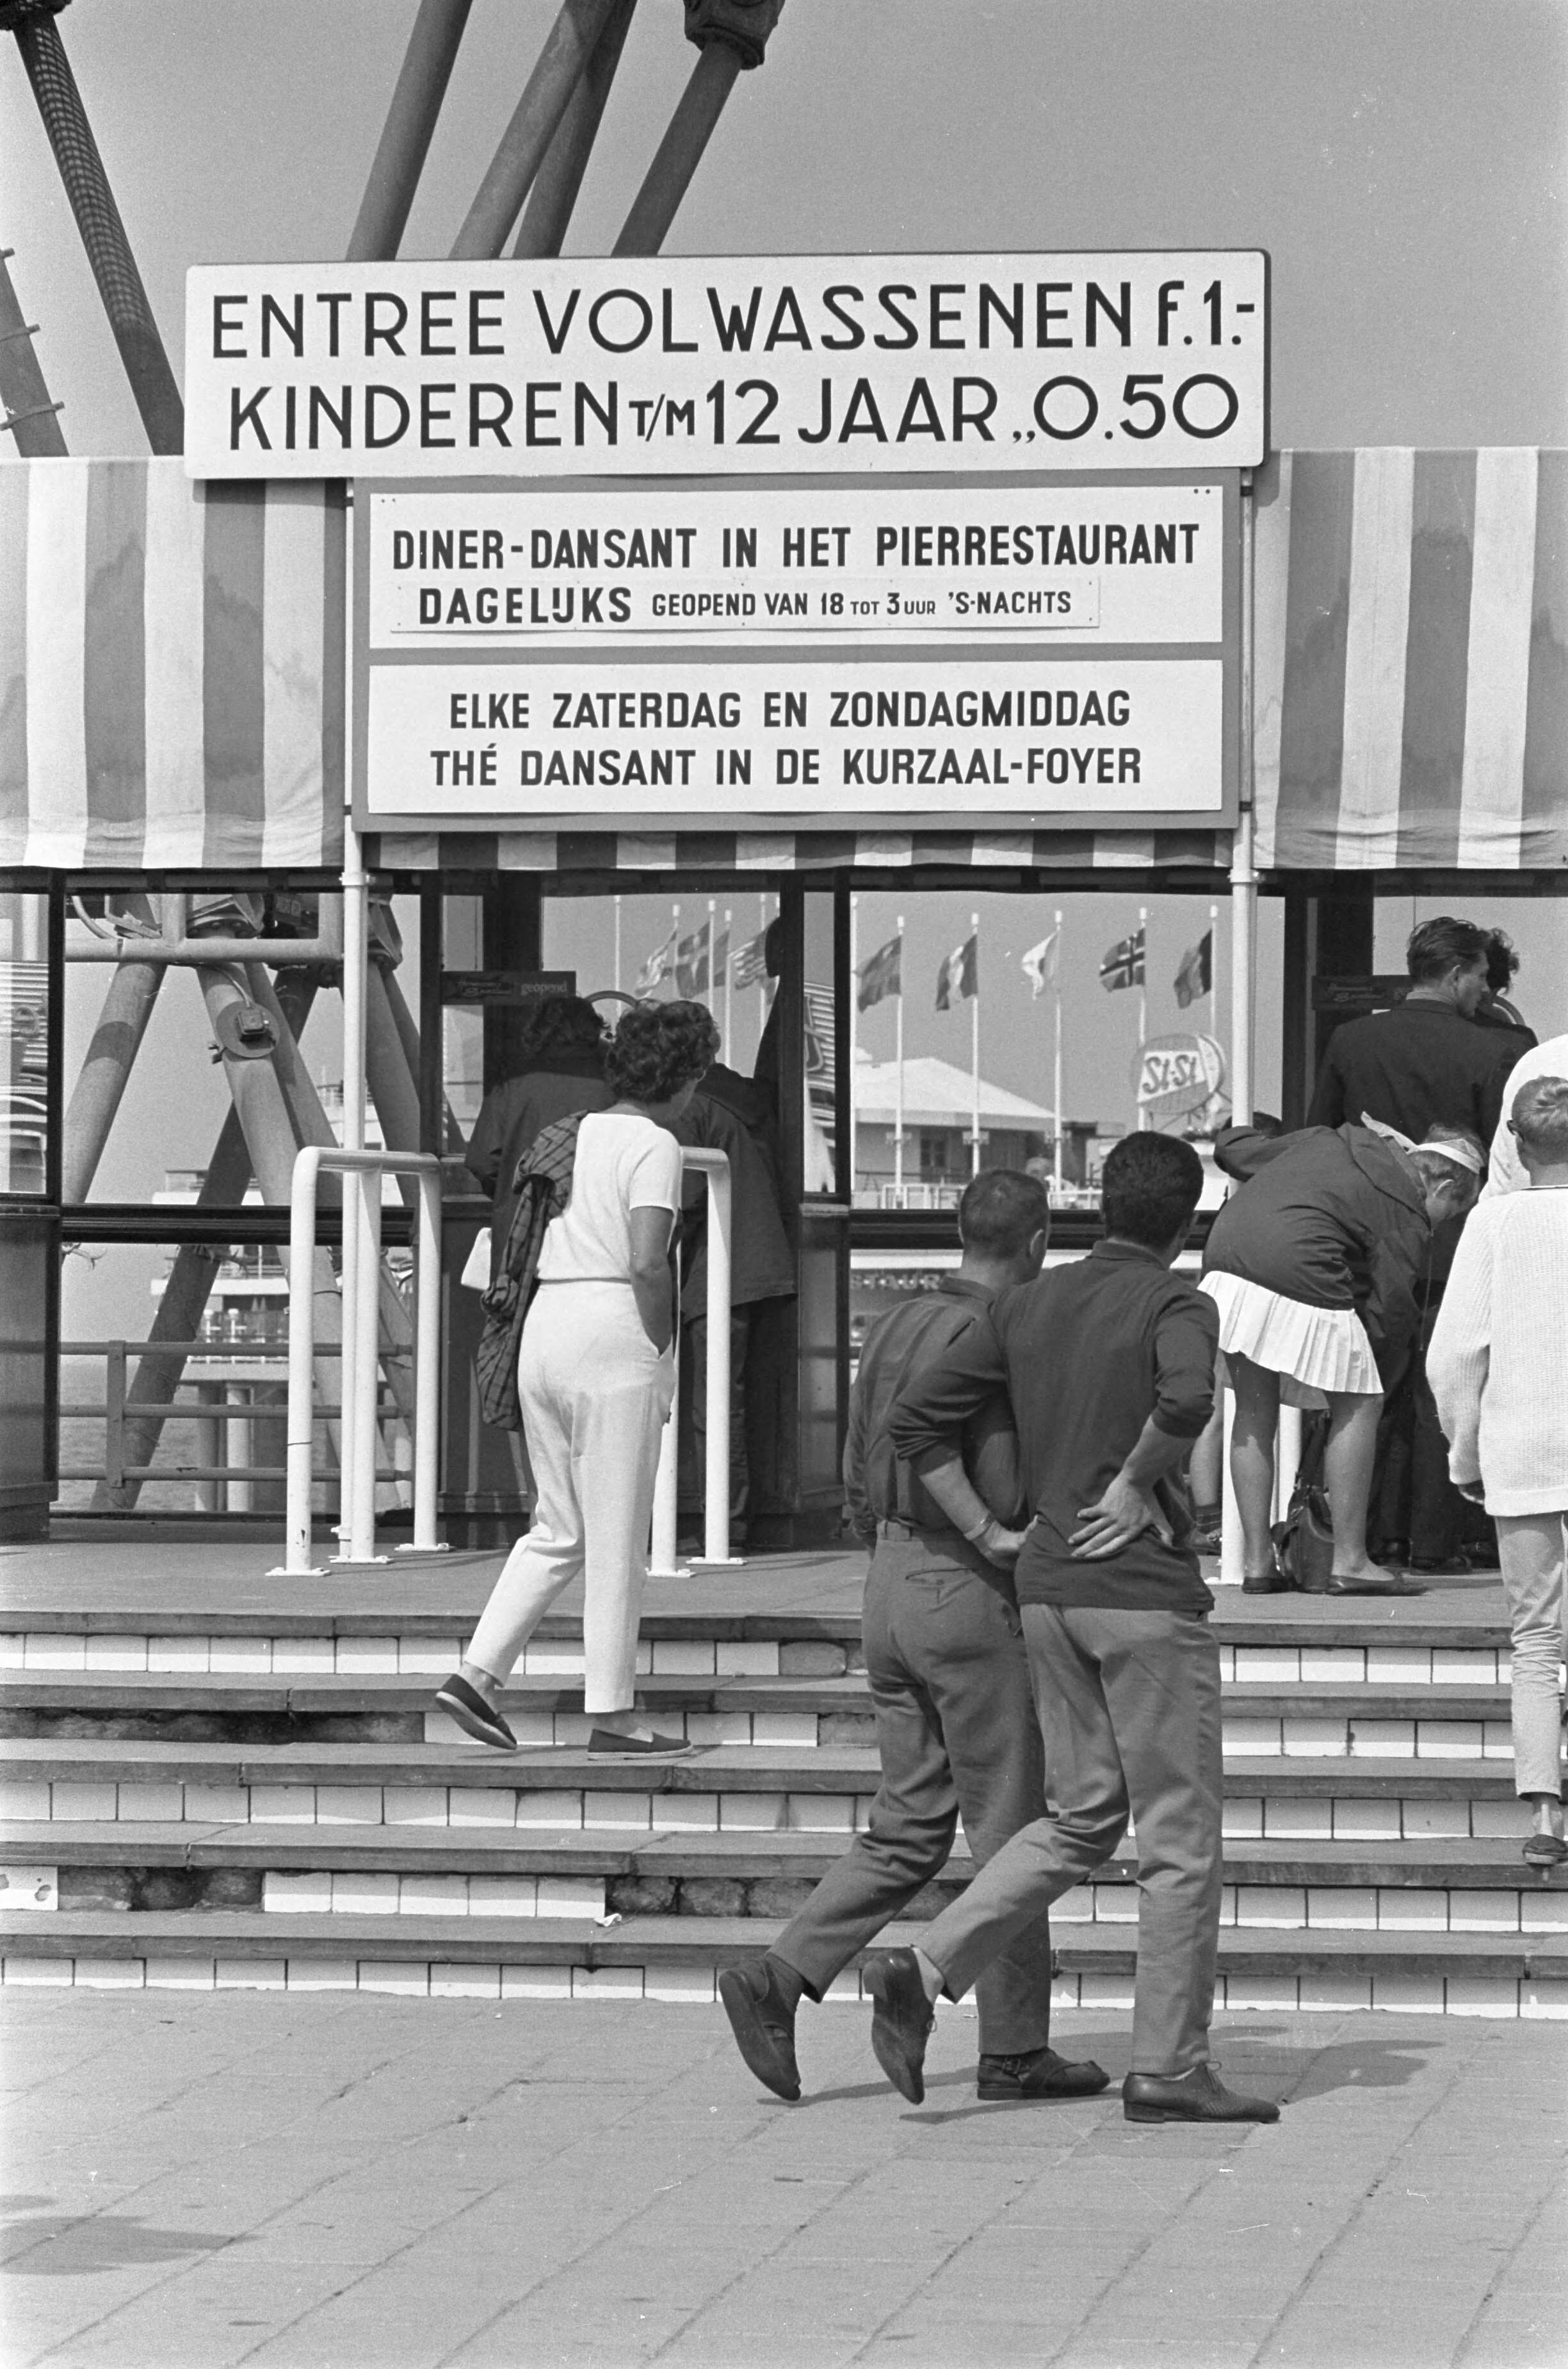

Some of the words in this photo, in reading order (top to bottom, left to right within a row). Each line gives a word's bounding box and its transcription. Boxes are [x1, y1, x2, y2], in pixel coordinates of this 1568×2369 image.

[214, 291, 504, 357] ENTREE
[533, 282, 1131, 353] VOLWASSENEN
[231, 382, 617, 449] KINDEREN
[629, 394, 694, 441] T/M
[707, 380, 779, 444] 12
[798, 377, 997, 443] JAAR
[394, 529, 697, 569] DINER-DANSANT
[723, 528, 756, 567] IN
[784, 528, 850, 567] HET
[877, 524, 1199, 565] PIERRESTAURANT
[420, 588, 631, 624] DAGELIJKS
[653, 594, 755, 615] GEOPEND
[764, 594, 807, 615] VAN
[821, 593, 843, 615] 18
[851, 602, 879, 614] TOT
[887, 593, 899, 614] 3
[905, 601, 935, 614] UUR
[451, 694, 528, 728] ELKE
[553, 693, 740, 728] ZATERDAG
[764, 692, 806, 727] EN
[830, 690, 1129, 727] ZONDAGMIDDAG
[431, 743, 496, 785] THÉ
[522, 750, 695, 785] DANSANT
[717, 750, 750, 784] IN
[777, 750, 819, 784] DE
[844, 748, 1140, 784] KURZAAL-FOYER
